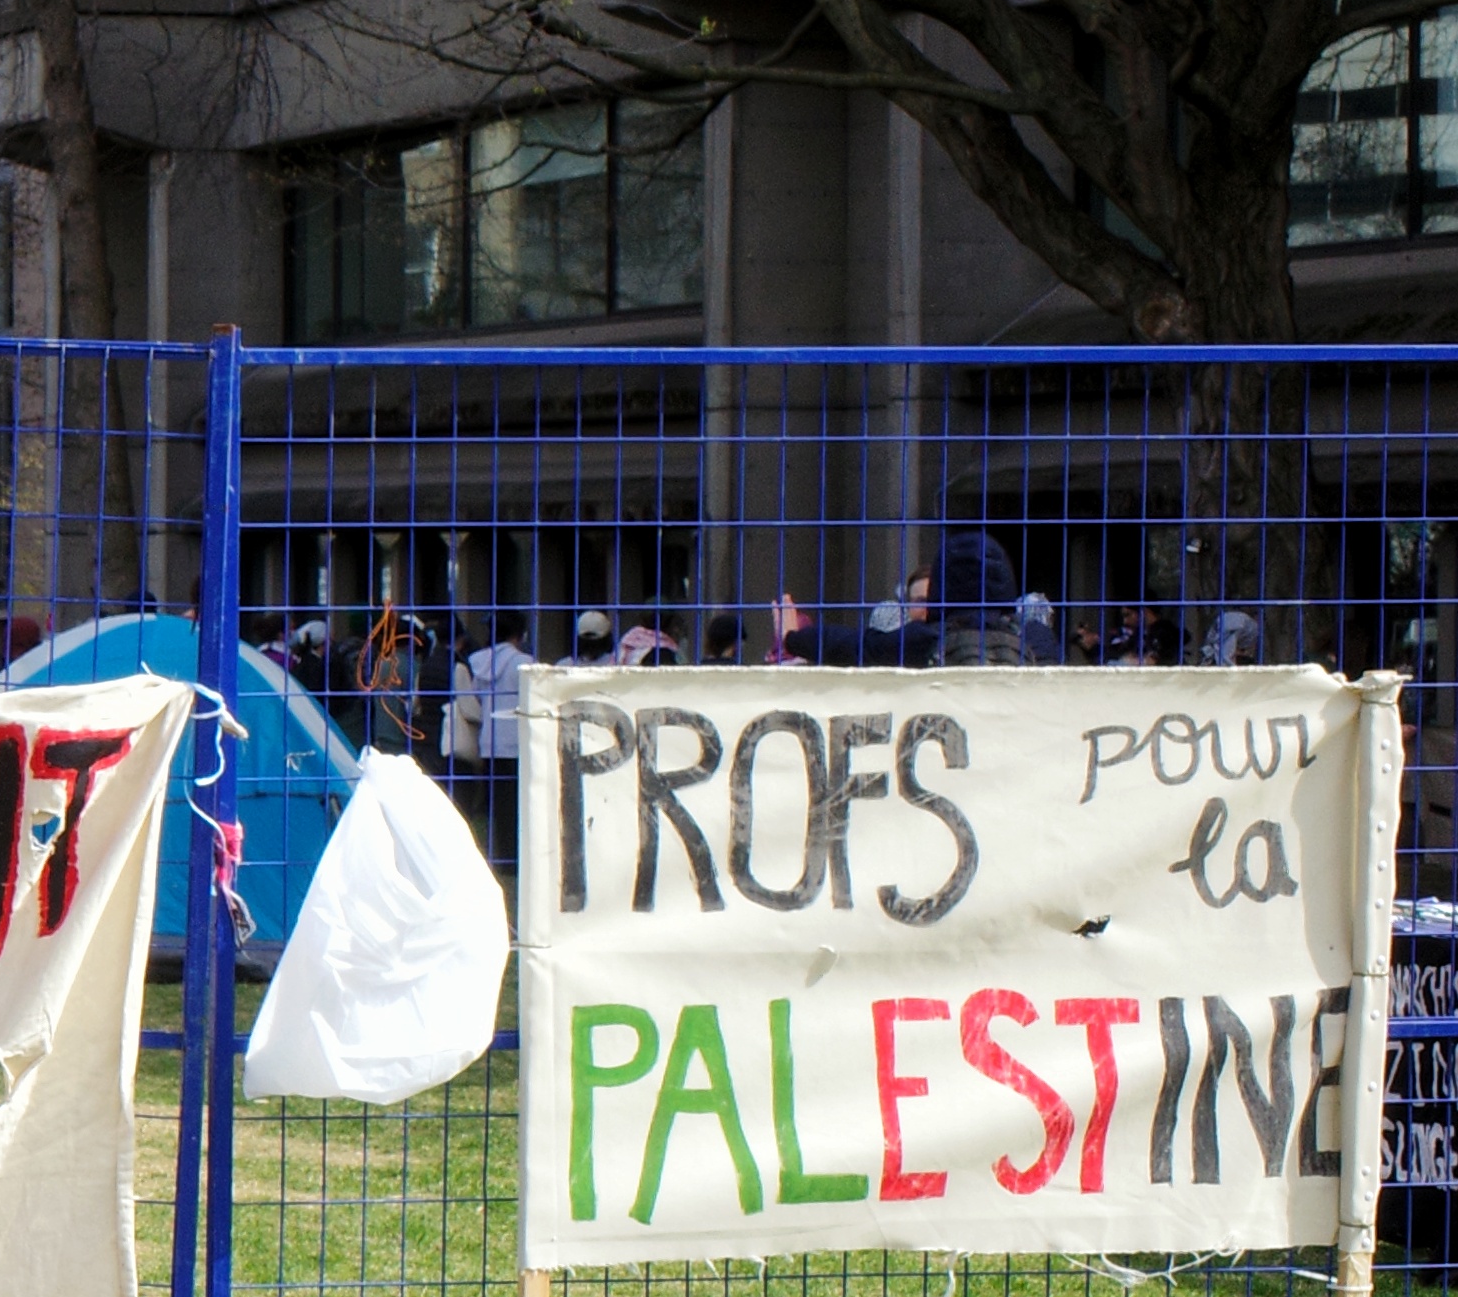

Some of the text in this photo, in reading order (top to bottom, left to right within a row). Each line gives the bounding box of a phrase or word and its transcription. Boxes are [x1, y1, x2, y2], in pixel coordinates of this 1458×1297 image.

[556, 699, 1316, 926] PROFS pour
[1168, 796, 1299, 909] la
[569, 986, 1352, 1225] PALESTINE
[1383, 1040, 1458, 1106] ZIN
